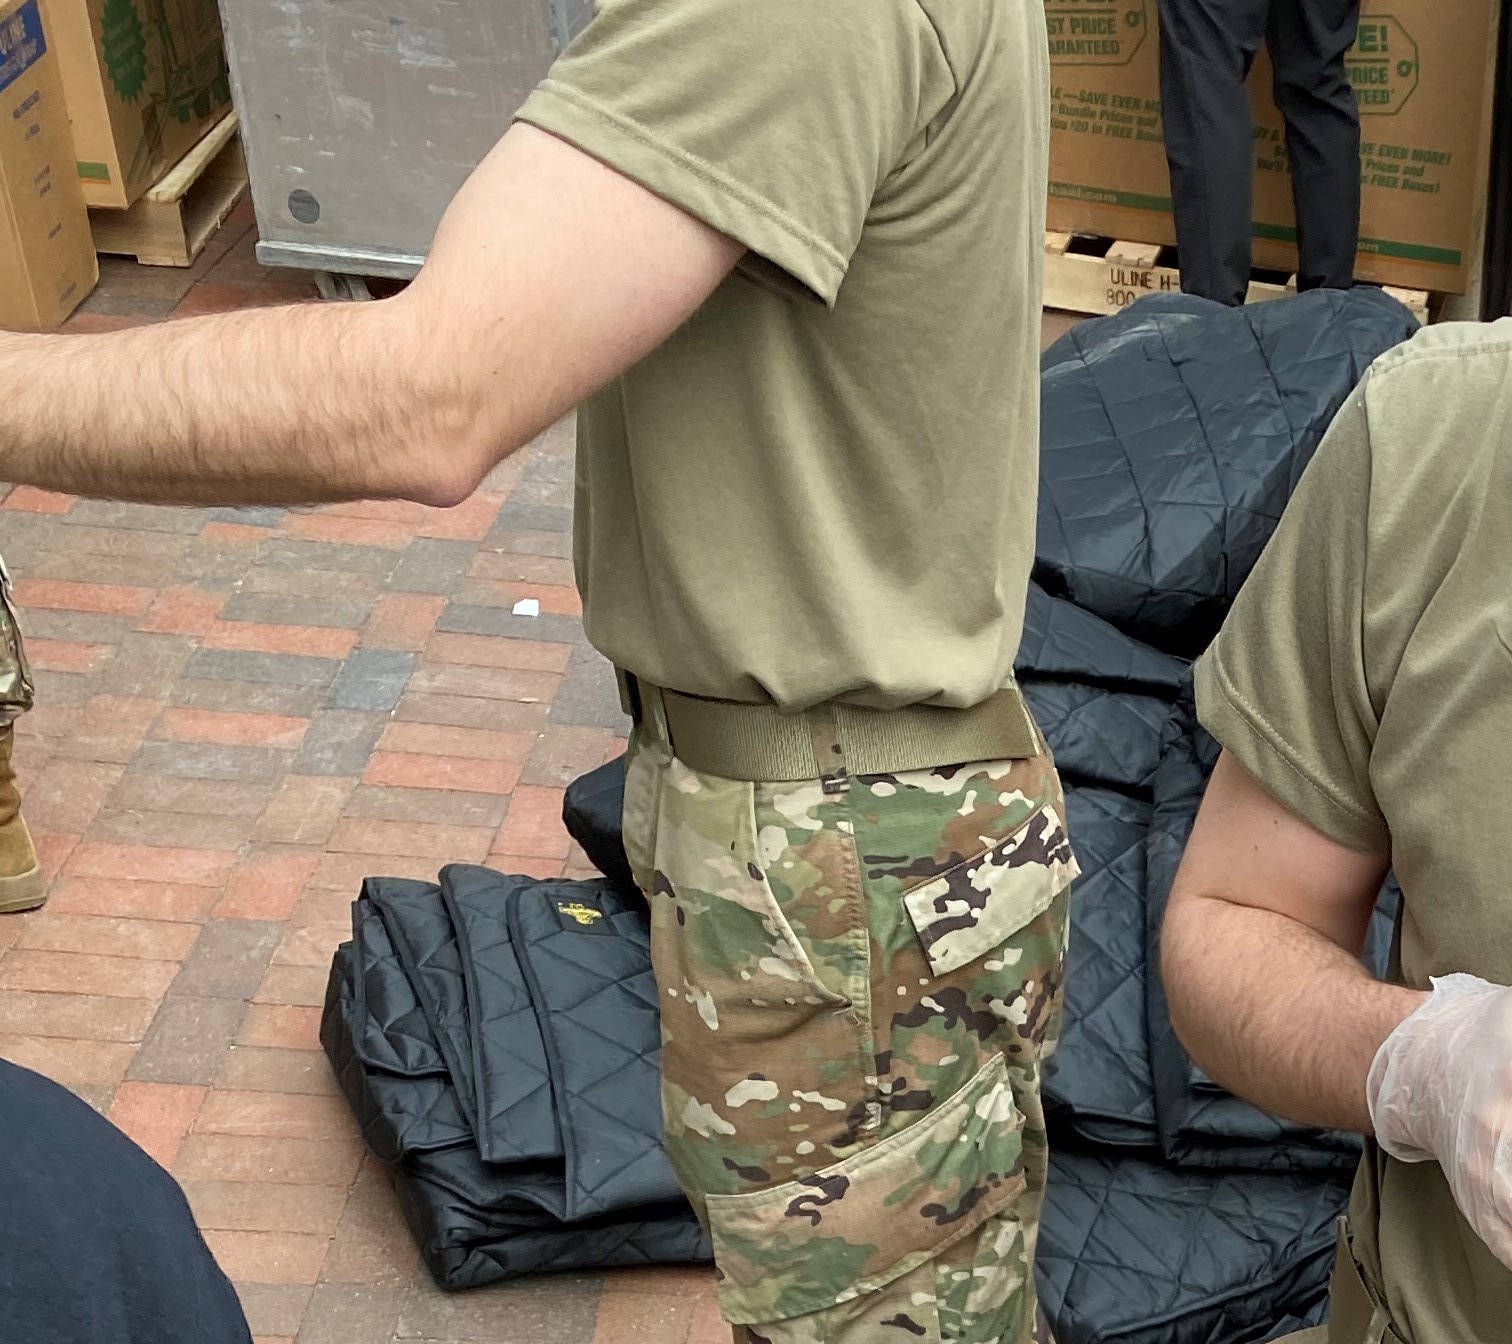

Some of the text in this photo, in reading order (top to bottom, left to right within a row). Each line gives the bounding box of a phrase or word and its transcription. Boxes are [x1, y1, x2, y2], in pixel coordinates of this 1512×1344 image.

[1070, 17, 1117, 35] PRICE
[1379, 143, 1451, 166] EVEN MORE!
[1370, 174, 1399, 189] FREE
[1110, 268, 1153, 289] ULINE
